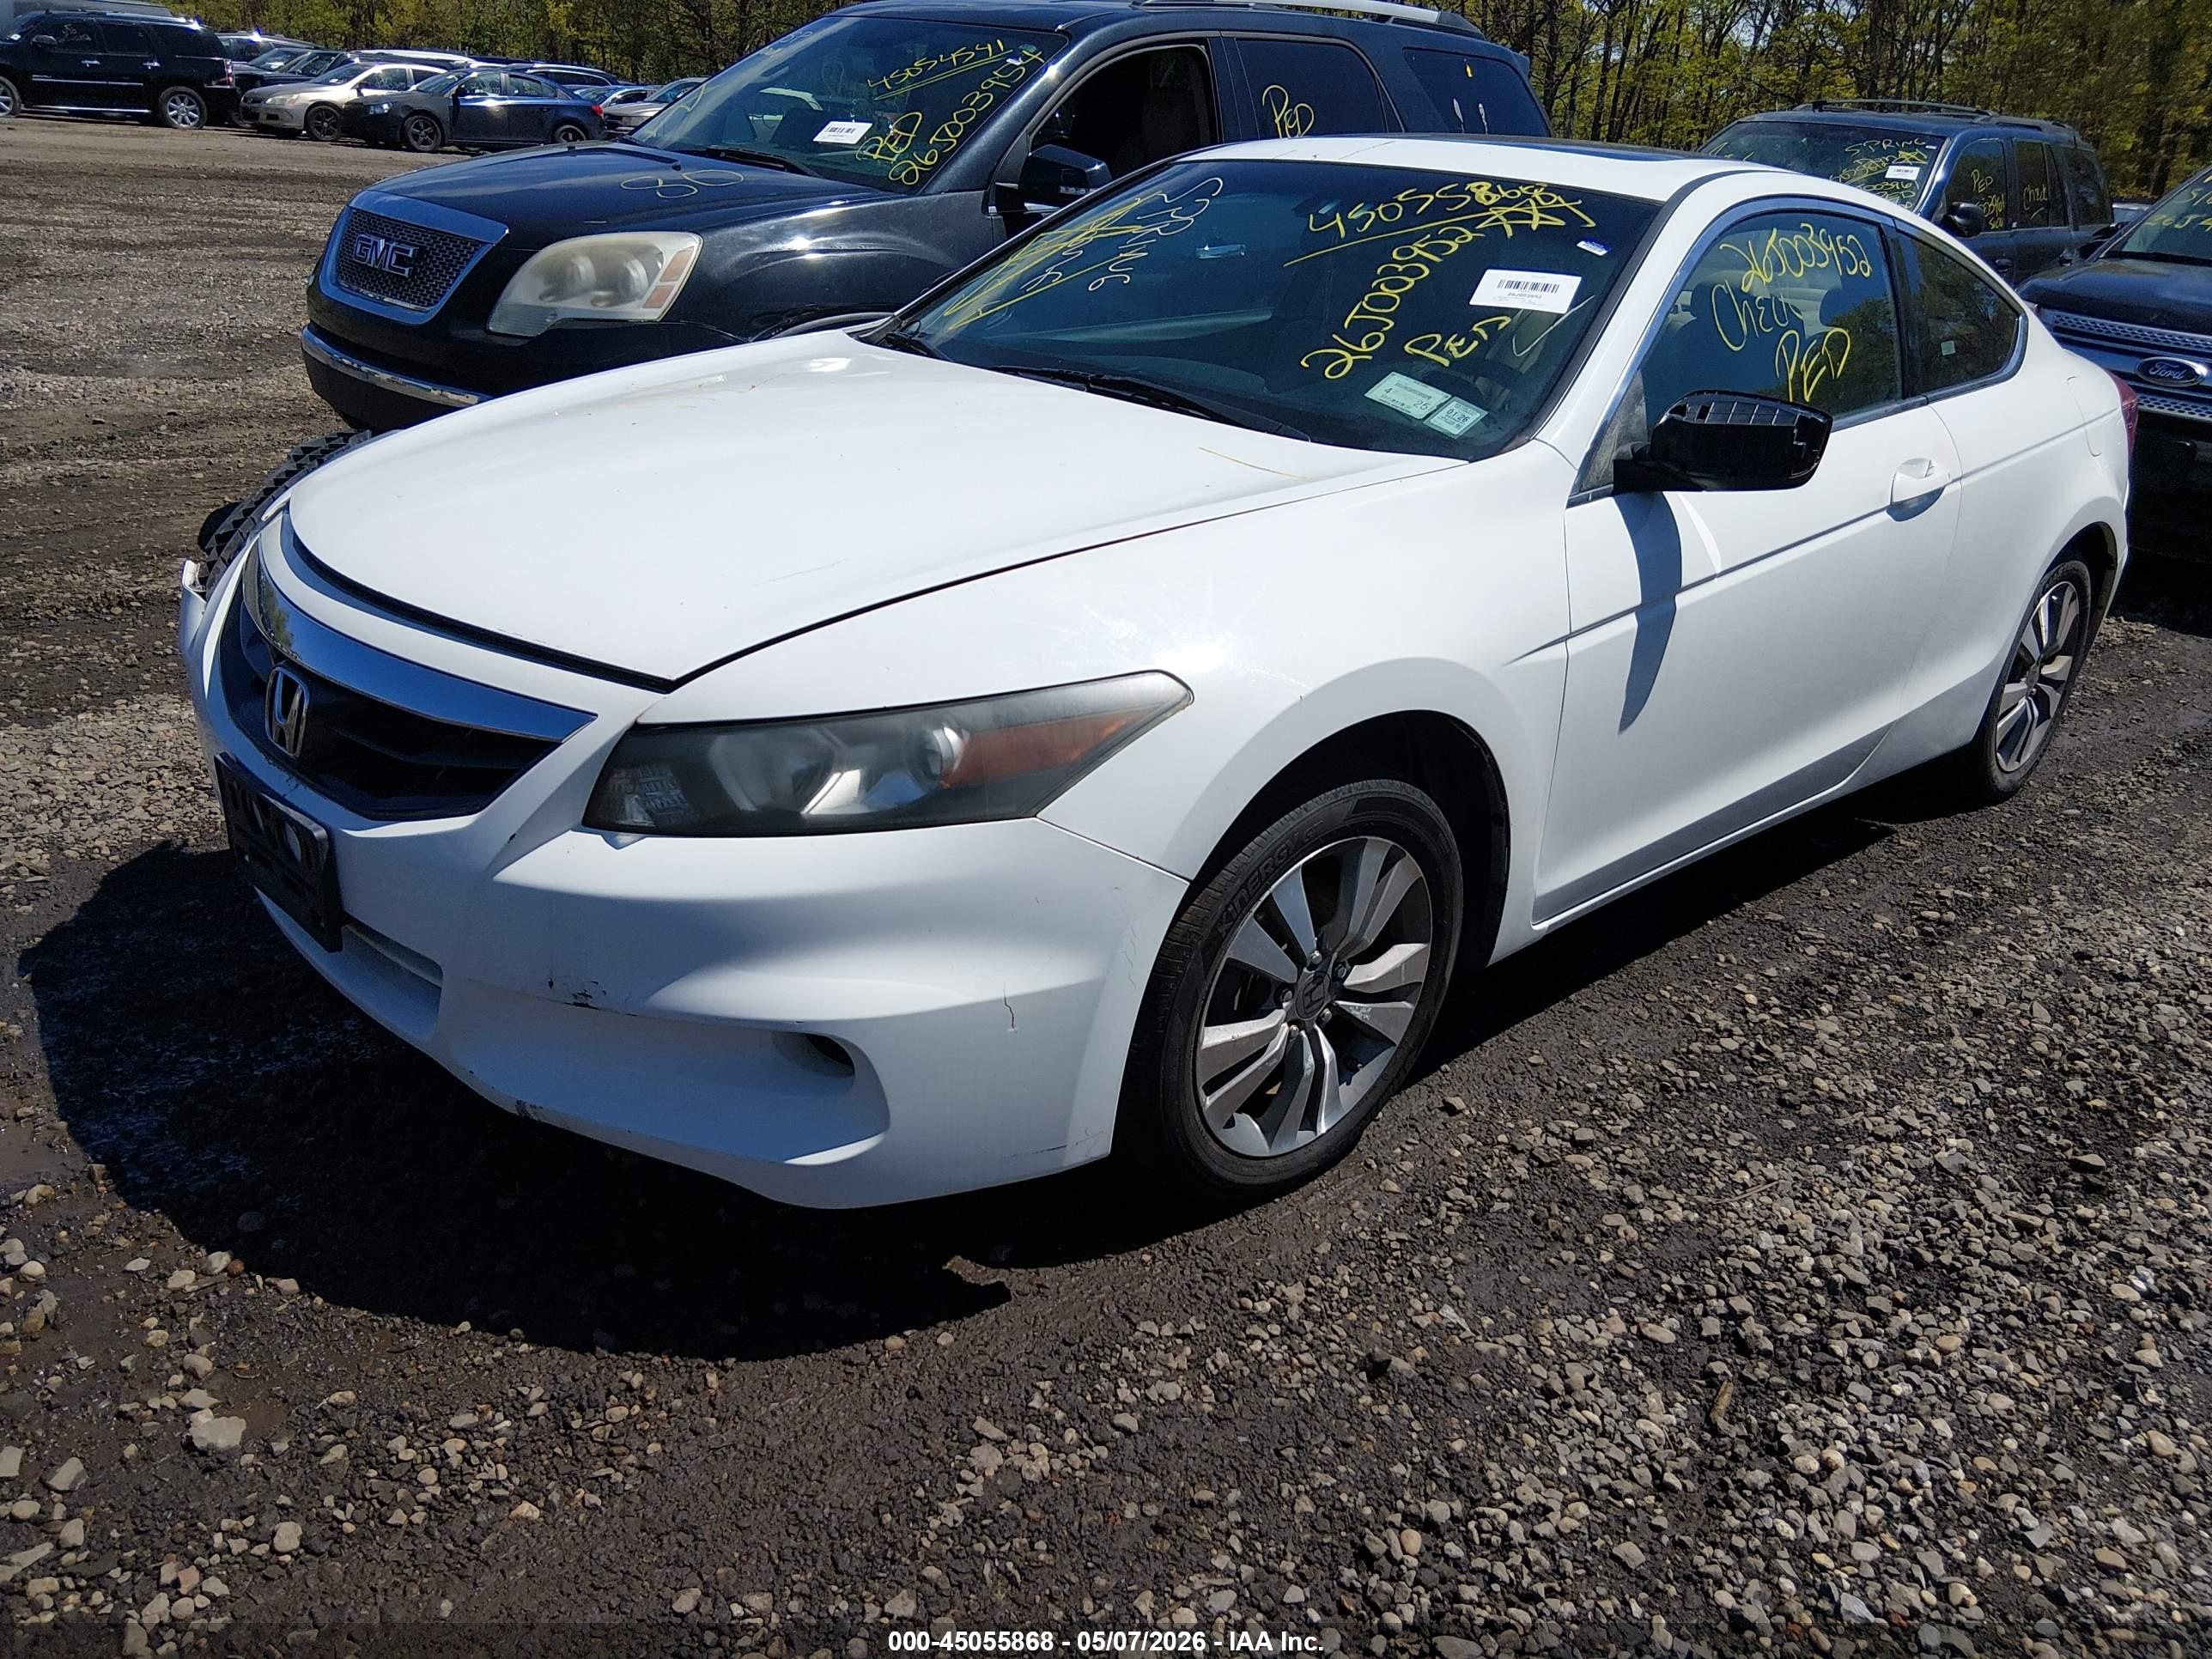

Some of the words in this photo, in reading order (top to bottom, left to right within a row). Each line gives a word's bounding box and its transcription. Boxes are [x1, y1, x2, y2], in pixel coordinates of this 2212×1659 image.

[353, 234, 416, 277] GMC
[1774, 326, 1851, 403] PED
[2148, 362, 2187, 380] Ford
